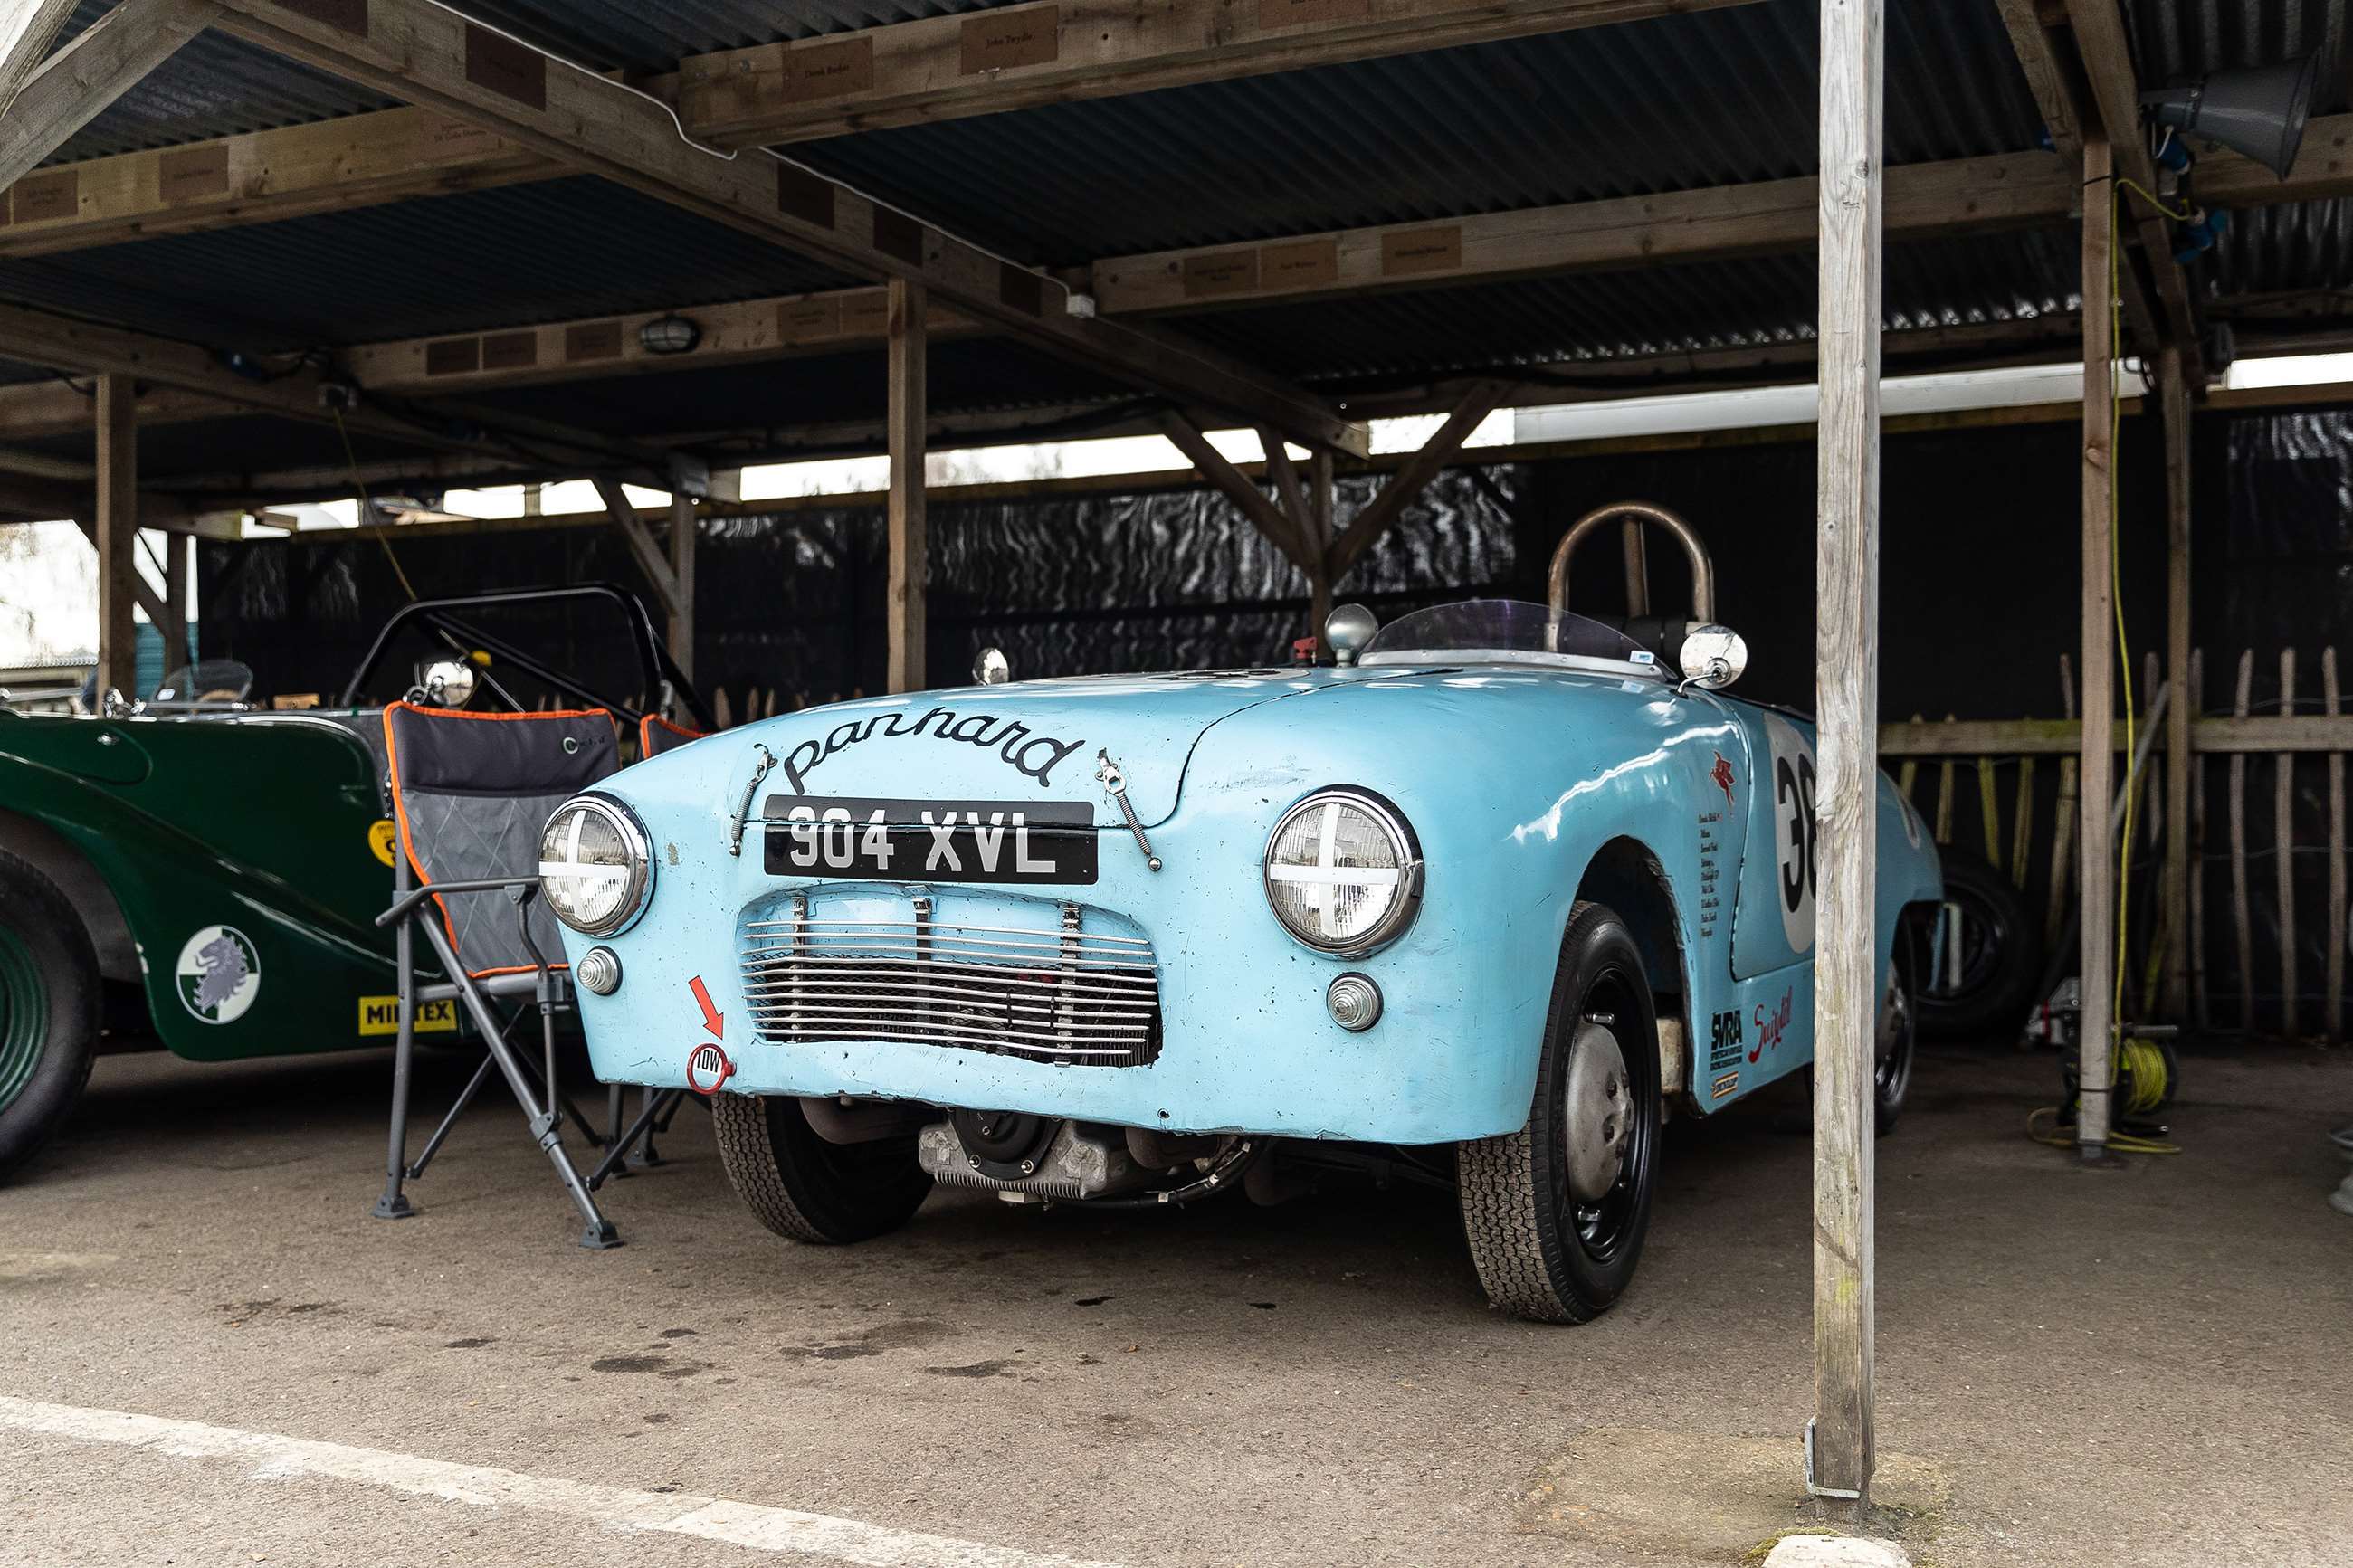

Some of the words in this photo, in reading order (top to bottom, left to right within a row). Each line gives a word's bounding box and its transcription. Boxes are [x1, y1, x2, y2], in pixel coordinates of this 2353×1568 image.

[788, 805, 894, 870] 904
[921, 811, 1056, 874] XVL
[1711, 1009, 1743, 1051] SVRA
